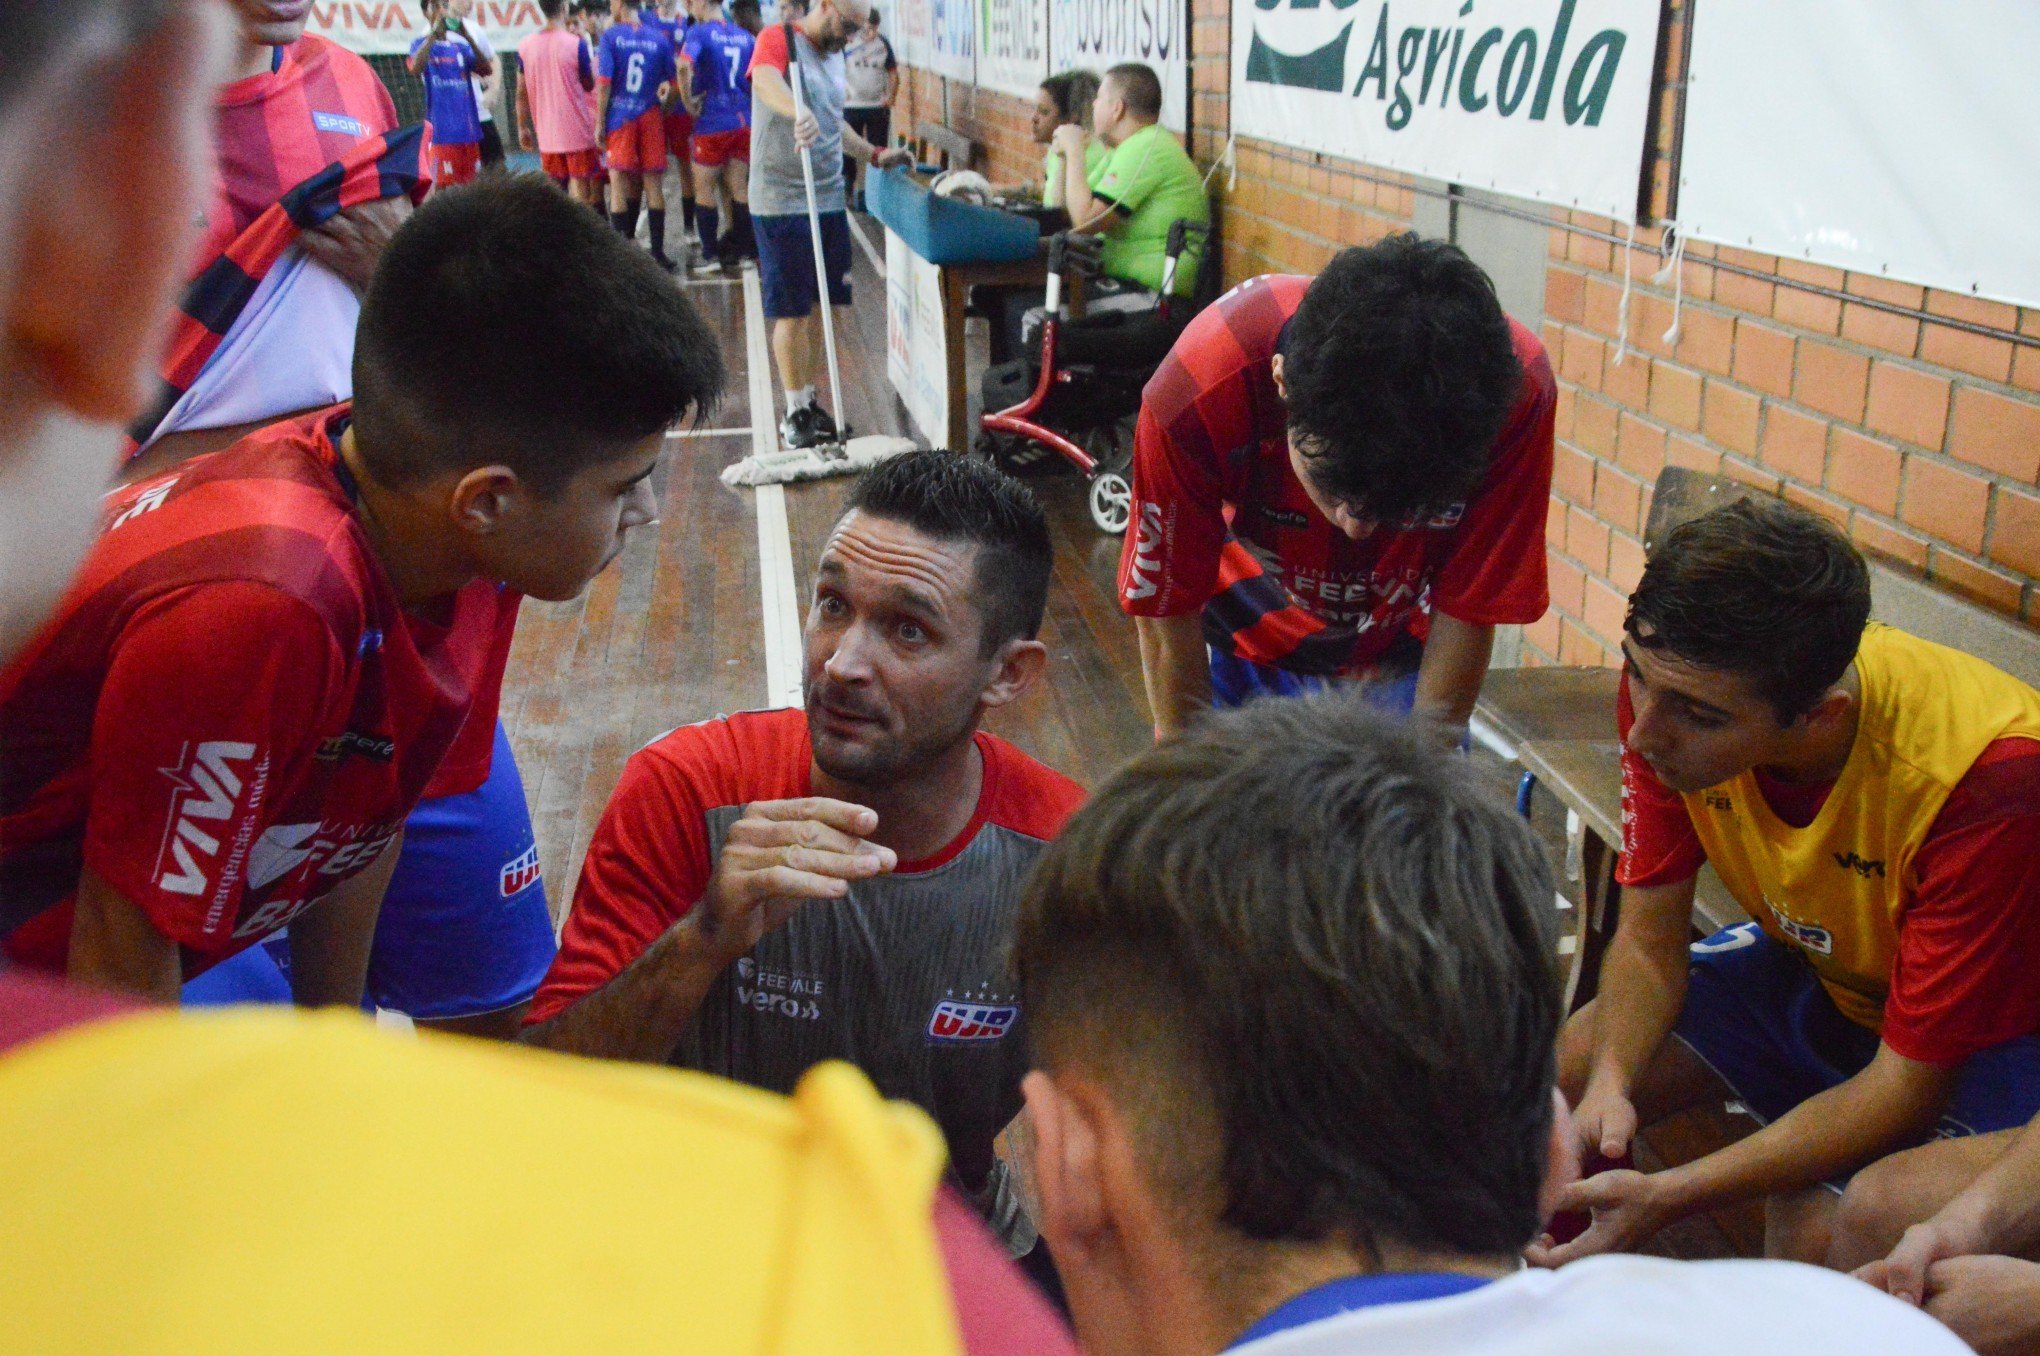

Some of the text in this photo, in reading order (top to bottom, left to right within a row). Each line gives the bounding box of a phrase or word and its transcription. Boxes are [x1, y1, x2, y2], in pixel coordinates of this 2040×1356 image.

[625, 52, 645, 94] 6
[723, 46, 741, 89] 7
[1353, 0, 1628, 131] Agrícola
[160, 741, 256, 896] VIVA
